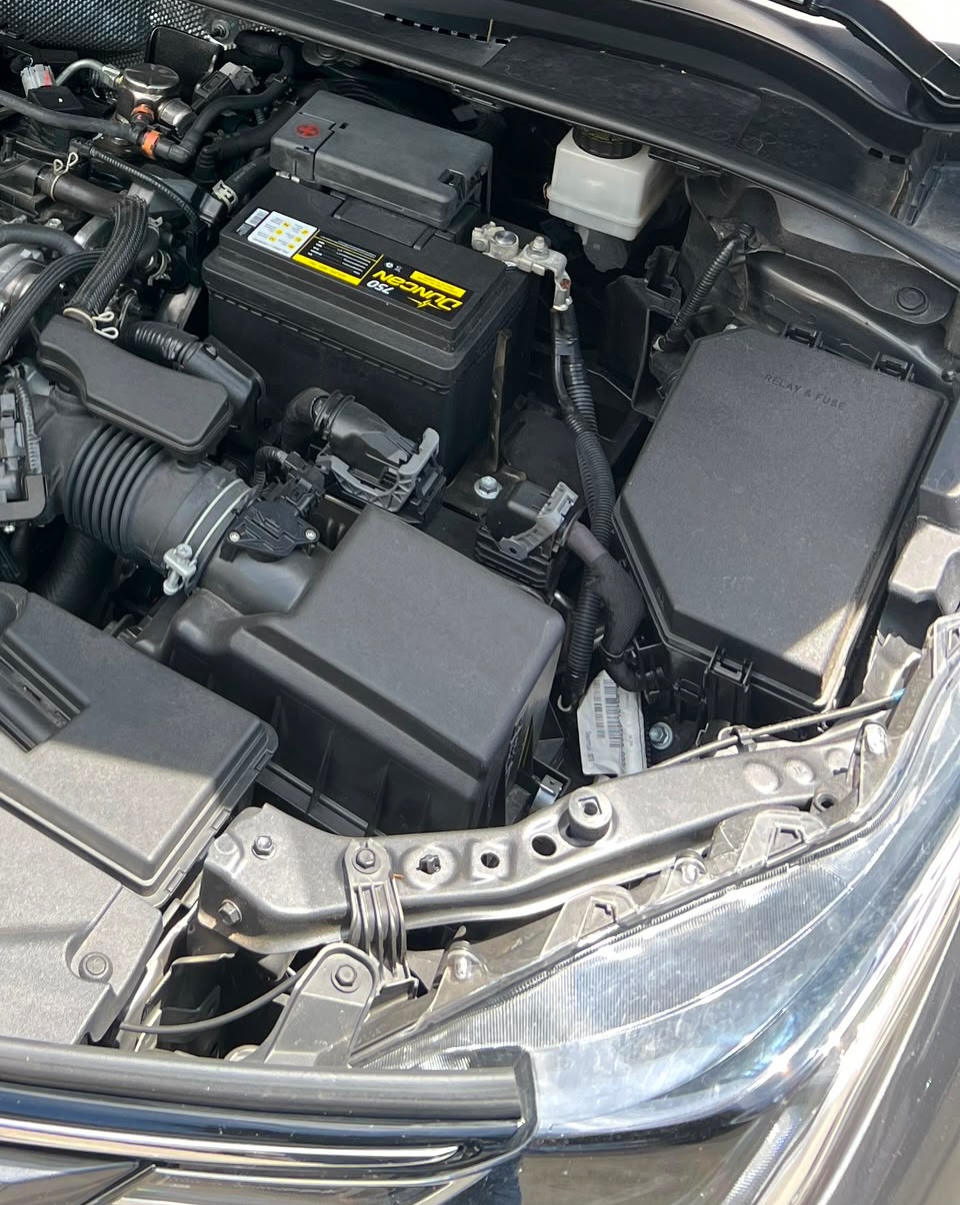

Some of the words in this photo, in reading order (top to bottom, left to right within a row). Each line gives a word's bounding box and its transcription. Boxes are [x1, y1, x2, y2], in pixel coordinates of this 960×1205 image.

[366, 279, 395, 295] 750
[764, 374, 802, 393] RELAY
[815, 393, 847, 411] FUSE
